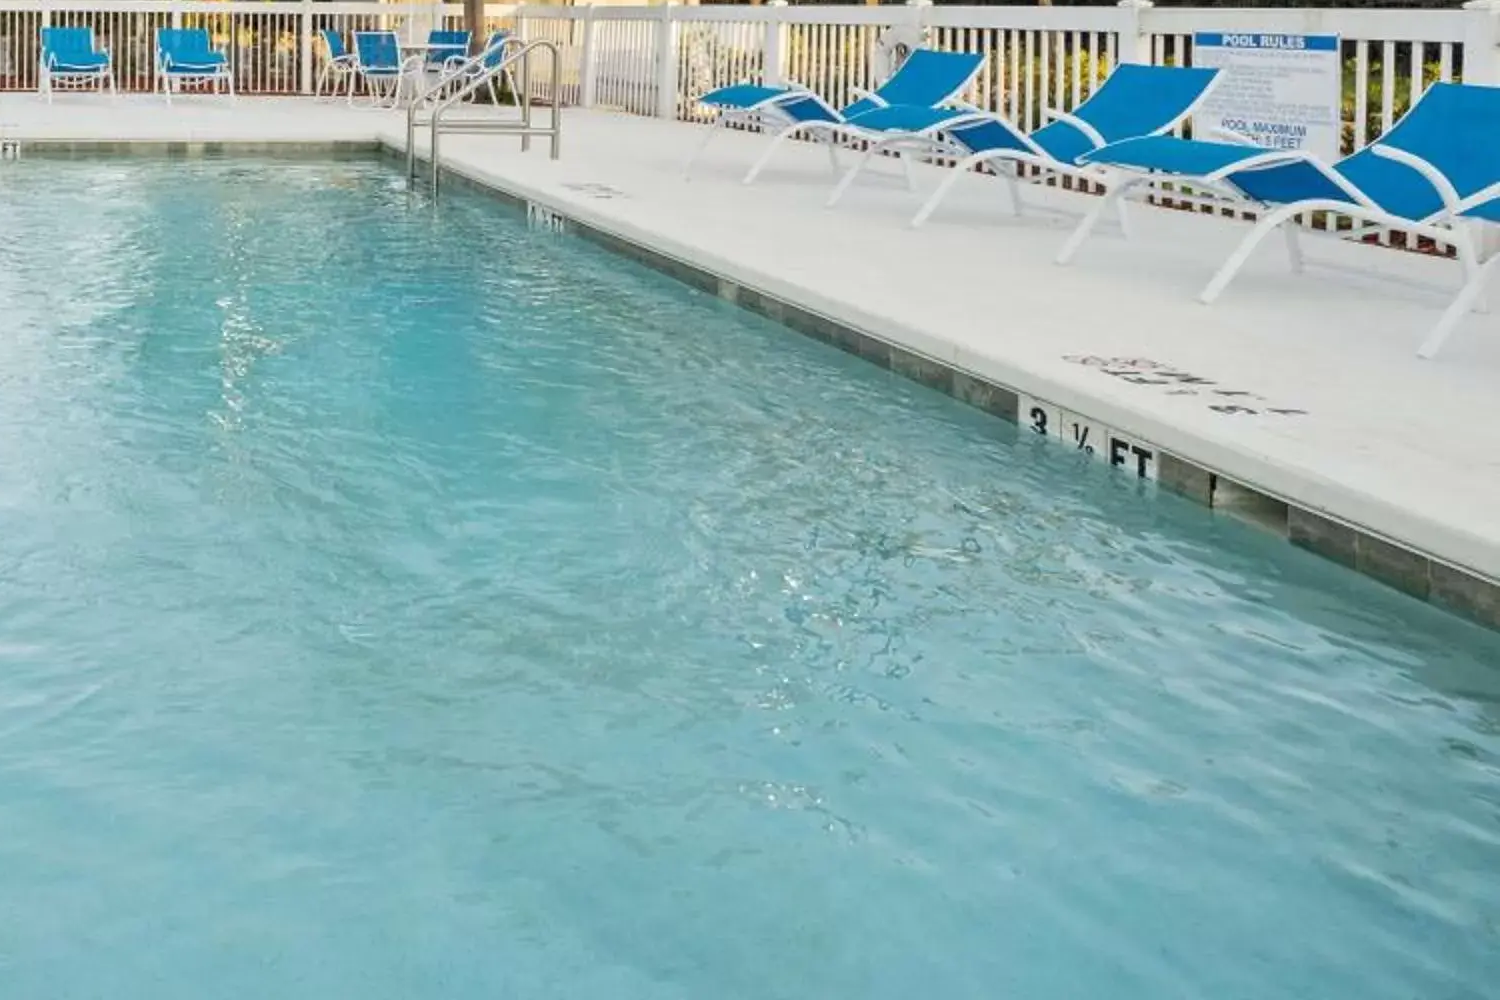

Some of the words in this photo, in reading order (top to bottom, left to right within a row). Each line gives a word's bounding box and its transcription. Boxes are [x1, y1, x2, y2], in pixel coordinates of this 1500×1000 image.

[1221, 34, 1257, 47] POOL
[1259, 35, 1305, 49] RULES
[1221, 118, 1250, 133] POOL
[1253, 122, 1307, 137] MAXIMUM
[1274, 136, 1303, 149] FEET
[1029, 407, 1048, 435] 3
[1110, 437, 1153, 478] FT
